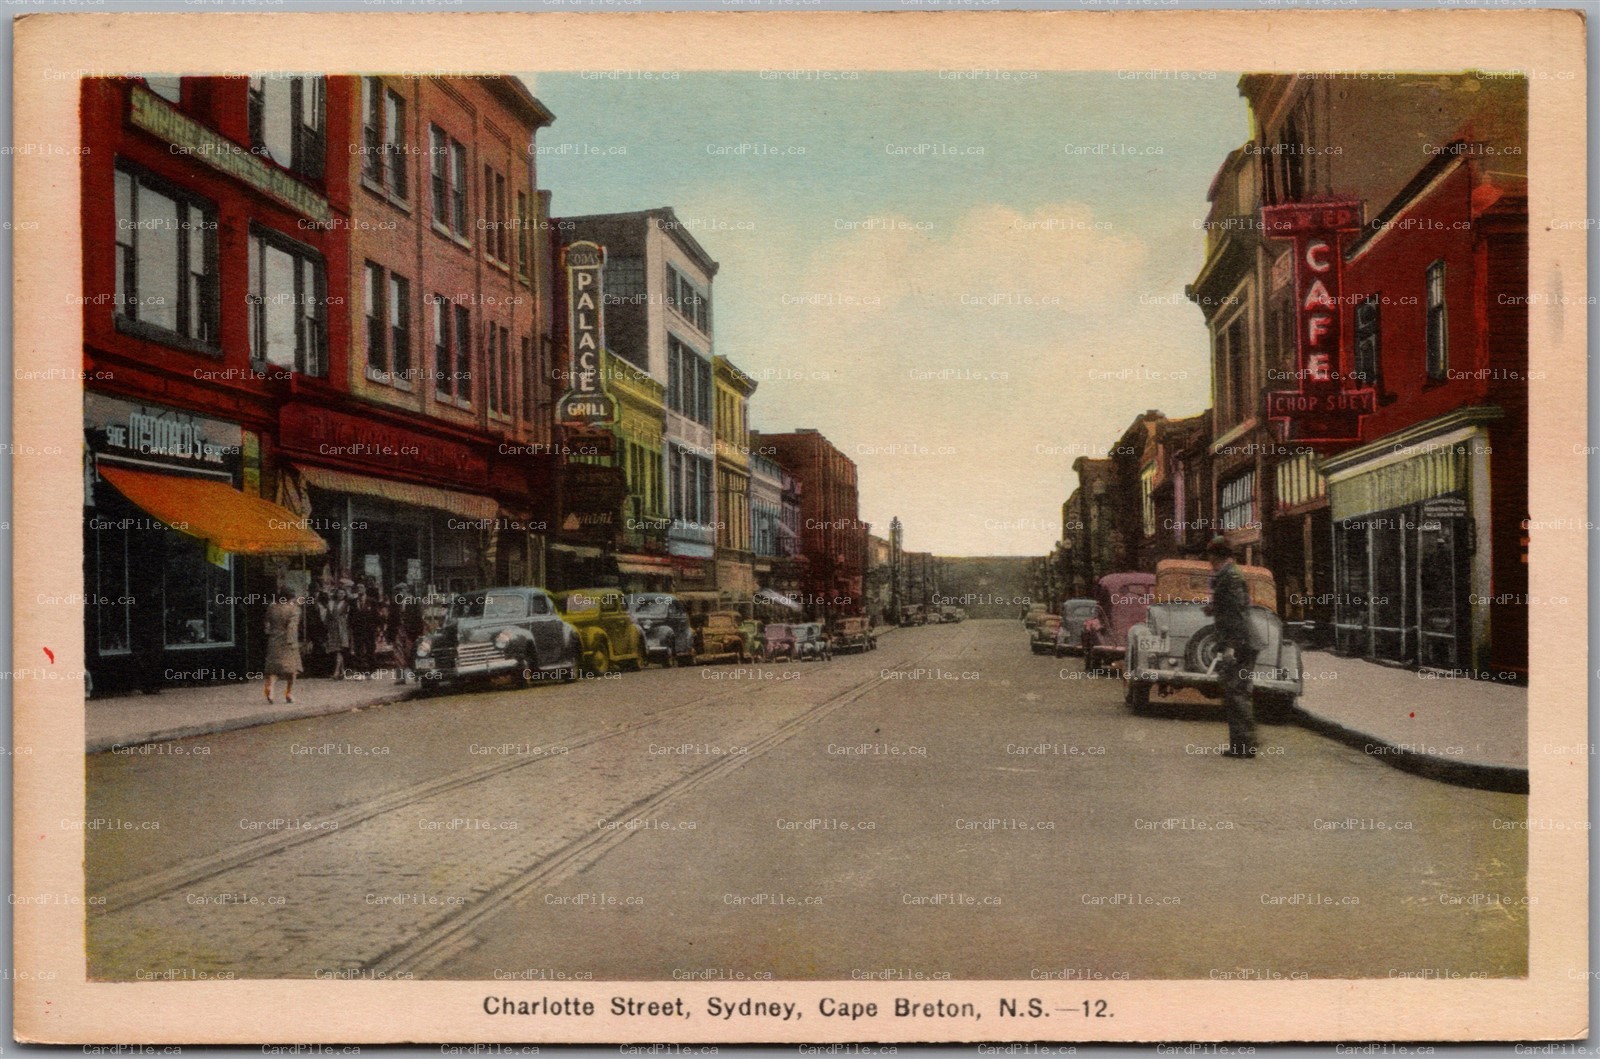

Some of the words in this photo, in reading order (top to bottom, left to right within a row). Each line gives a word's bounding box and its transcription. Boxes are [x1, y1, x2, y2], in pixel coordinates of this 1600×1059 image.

[1304, 243, 1335, 382] CAFE
[577, 272, 596, 391] PALACE
[568, 402, 608, 416] GRILL
[1276, 396, 1318, 412] CHOP
[1327, 394, 1370, 410] SUEY
[484, 996, 595, 1016] Charlotte
[611, 996, 690, 1019] Street,
[708, 996, 802, 1020] Sydney,
[819, 998, 878, 1020] Cape
[895, 998, 982, 1020] Breton,
